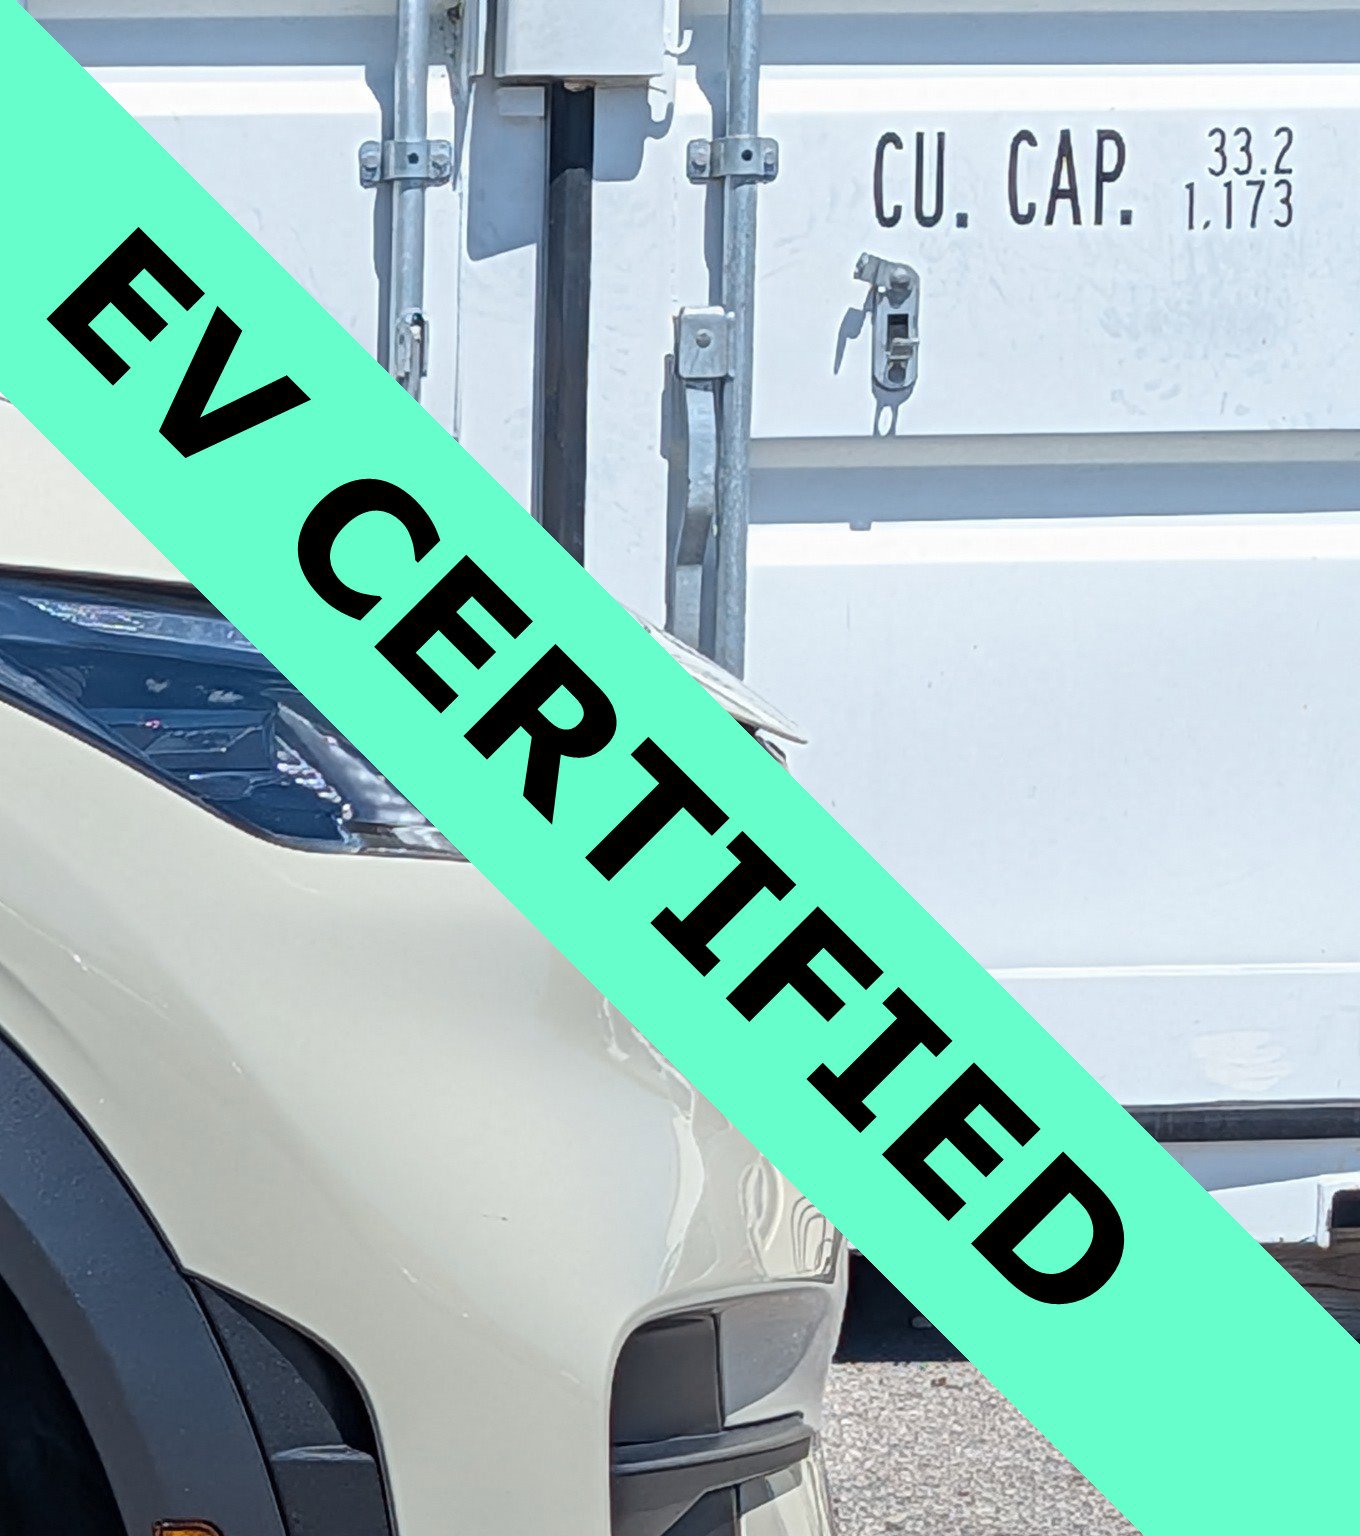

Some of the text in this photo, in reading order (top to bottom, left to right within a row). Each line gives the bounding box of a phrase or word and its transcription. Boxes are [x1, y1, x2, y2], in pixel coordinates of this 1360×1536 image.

[873, 129, 1132, 228] CU. CAP.
[1208, 127, 1293, 177] 33.2
